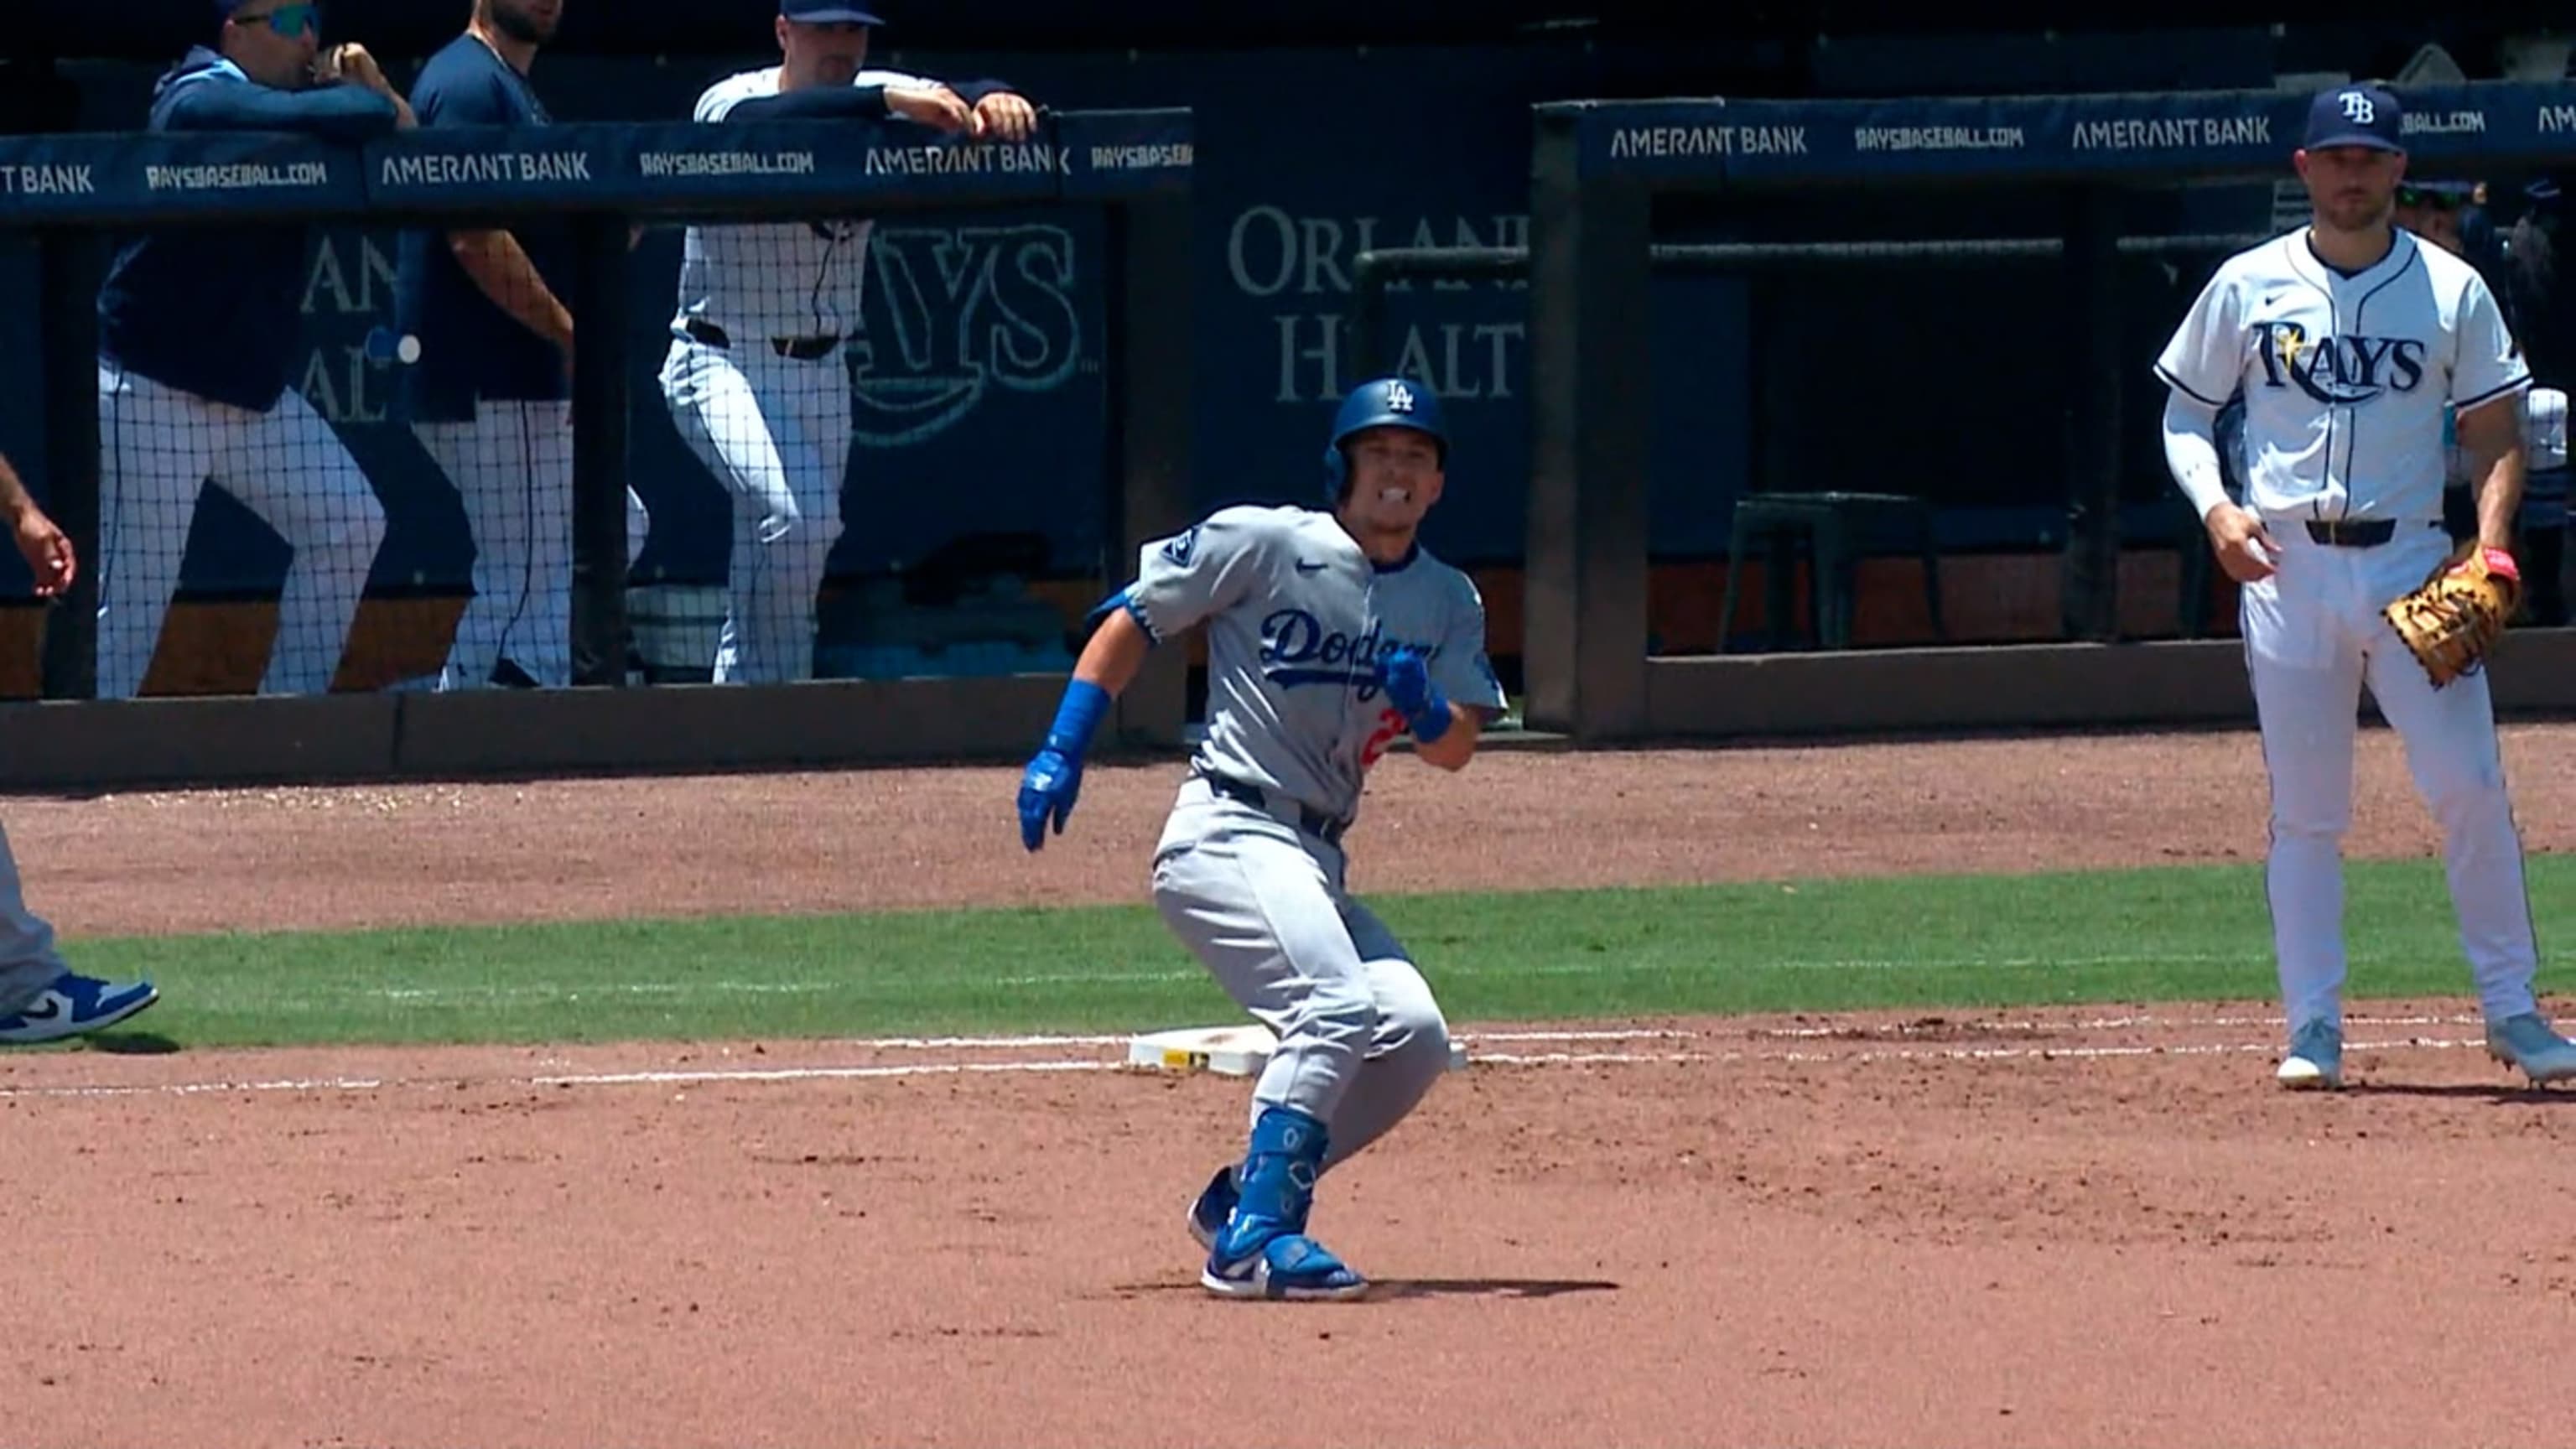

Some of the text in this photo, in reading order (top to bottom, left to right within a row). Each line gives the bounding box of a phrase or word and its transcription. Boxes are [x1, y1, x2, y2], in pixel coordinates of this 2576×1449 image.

[2338, 91, 2376, 125] TB
[1610, 126, 1808, 158] AMERANT BANK
[1854, 127, 2024, 152] RAYSBASEBALL.COM
[2071, 116, 2272, 149] AMERANT BANK
[146, 162, 328, 191] RAYSBASEBALL.COM
[382, 151, 591, 185] AMERANT BANK
[639, 151, 815, 178] RAYSBASEBALL.COM
[864, 145, 996, 176] AMERANT
[21, 164, 96, 194] BANK
[2252, 320, 2426, 403] RAYS
[1386, 379, 1414, 412] LA
